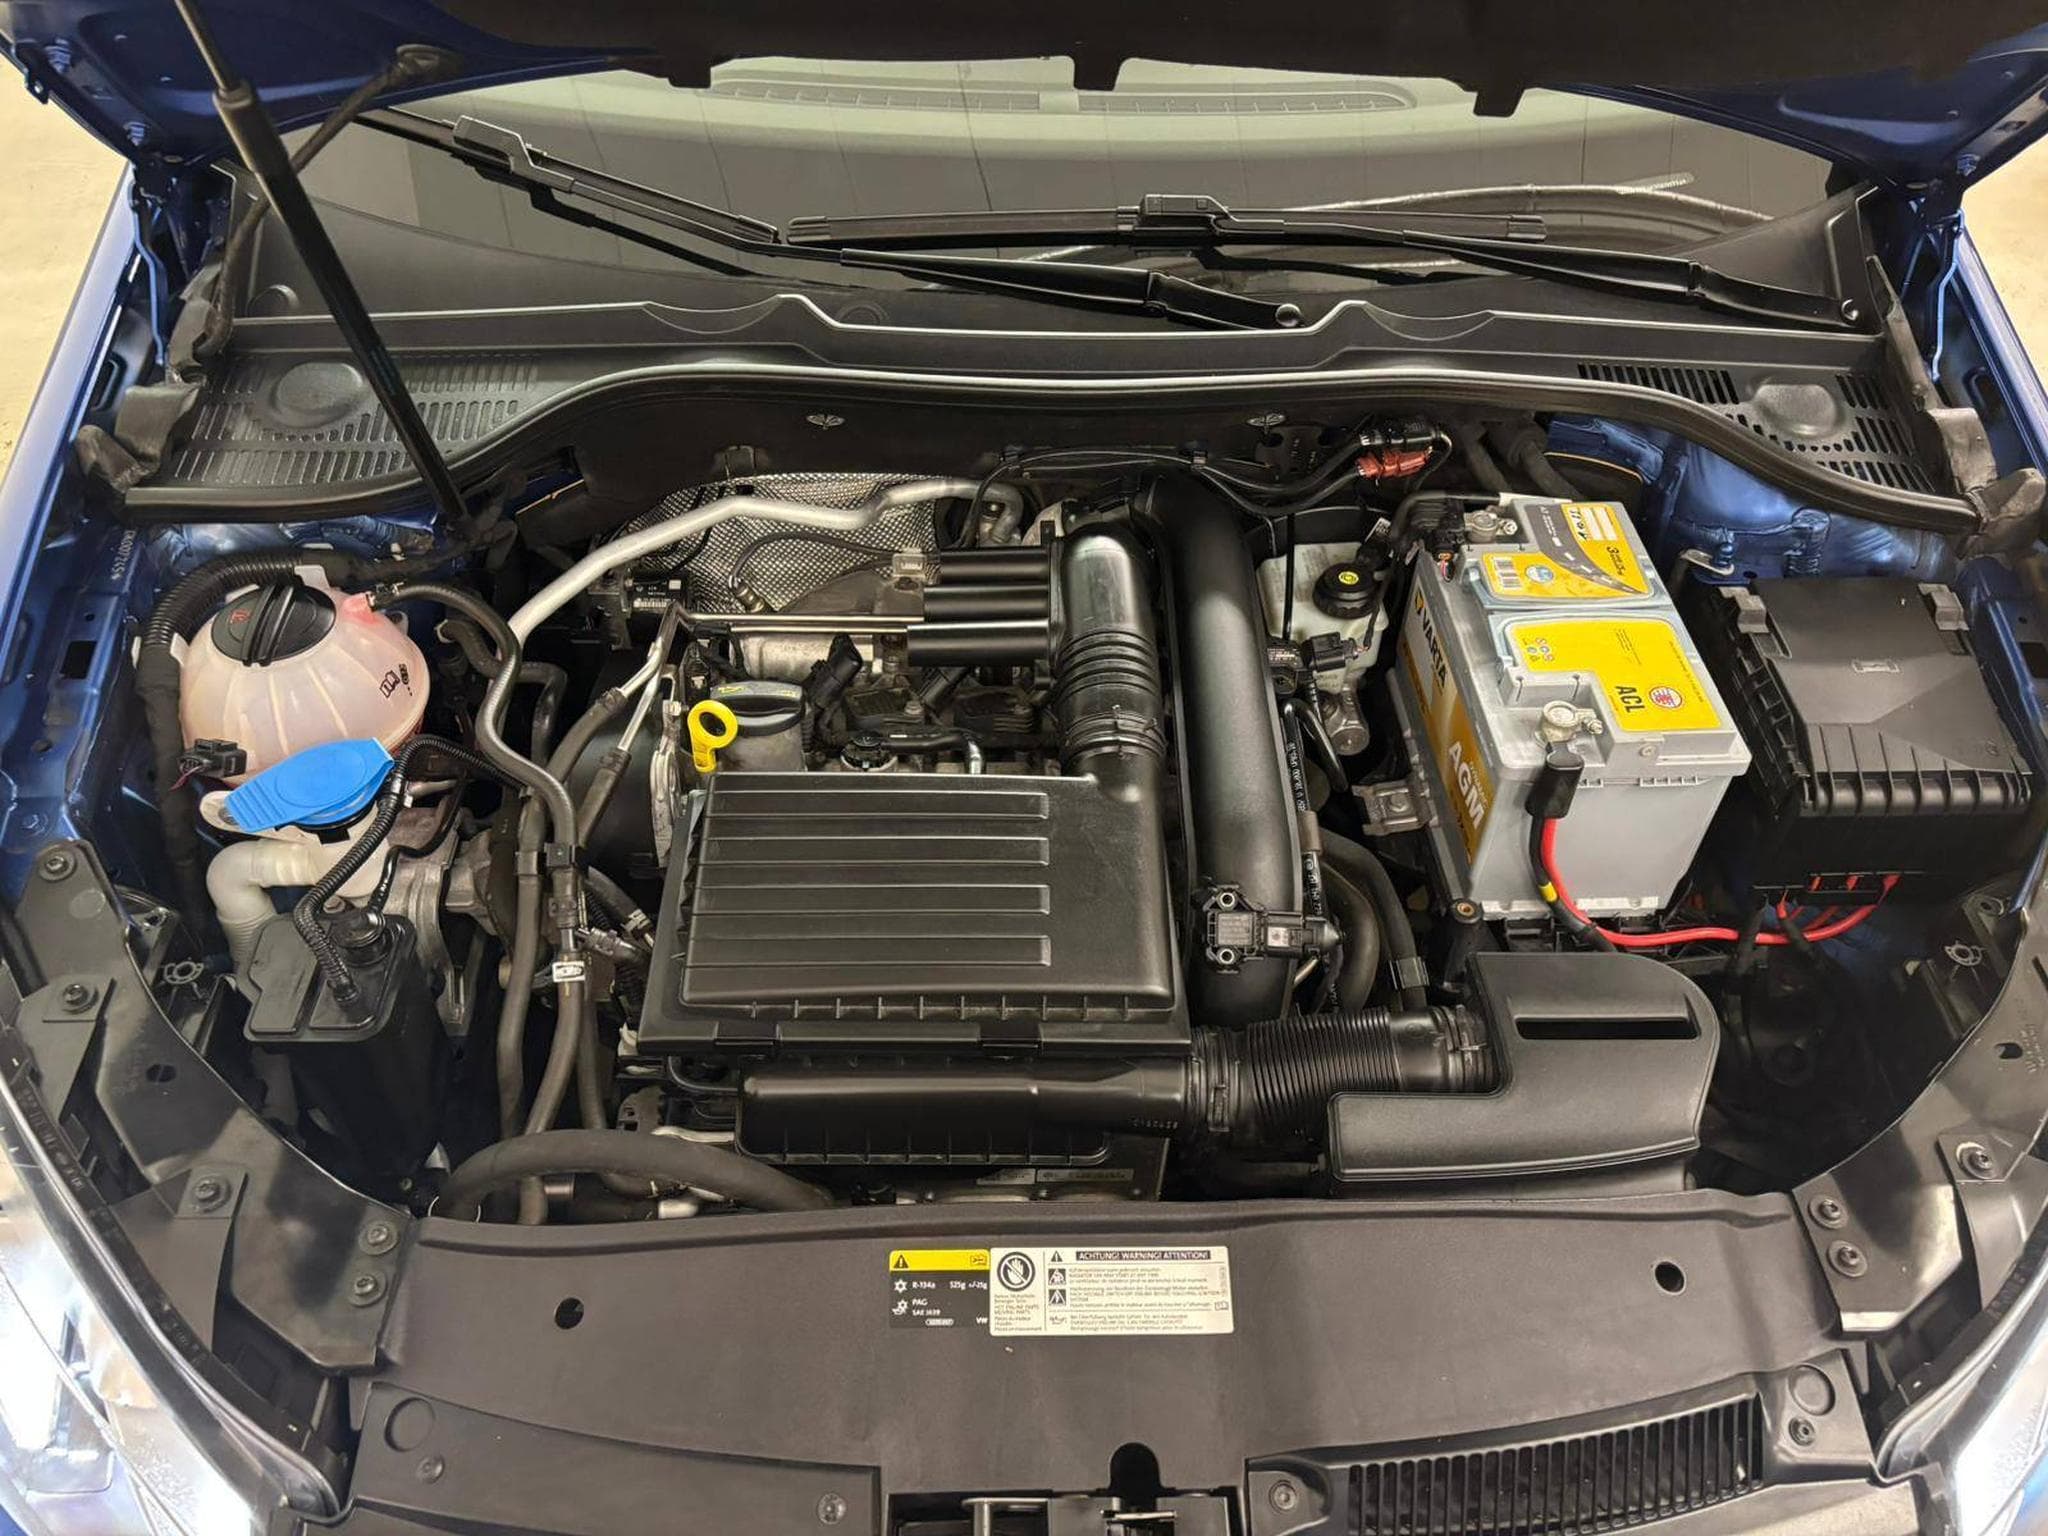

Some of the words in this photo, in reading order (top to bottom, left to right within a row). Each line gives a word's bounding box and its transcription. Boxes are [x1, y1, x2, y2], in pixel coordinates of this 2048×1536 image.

[1420, 611, 1447, 689] VARTA
[1615, 686, 1645, 713] ACL
[1450, 741, 1485, 829] AGM
[1079, 1251, 1119, 1260] ACHTUNG!
[1121, 1251, 1160, 1260] WARNING!
[1163, 1250, 1208, 1259] ATTENTION!
[911, 1298, 928, 1306] PAG
